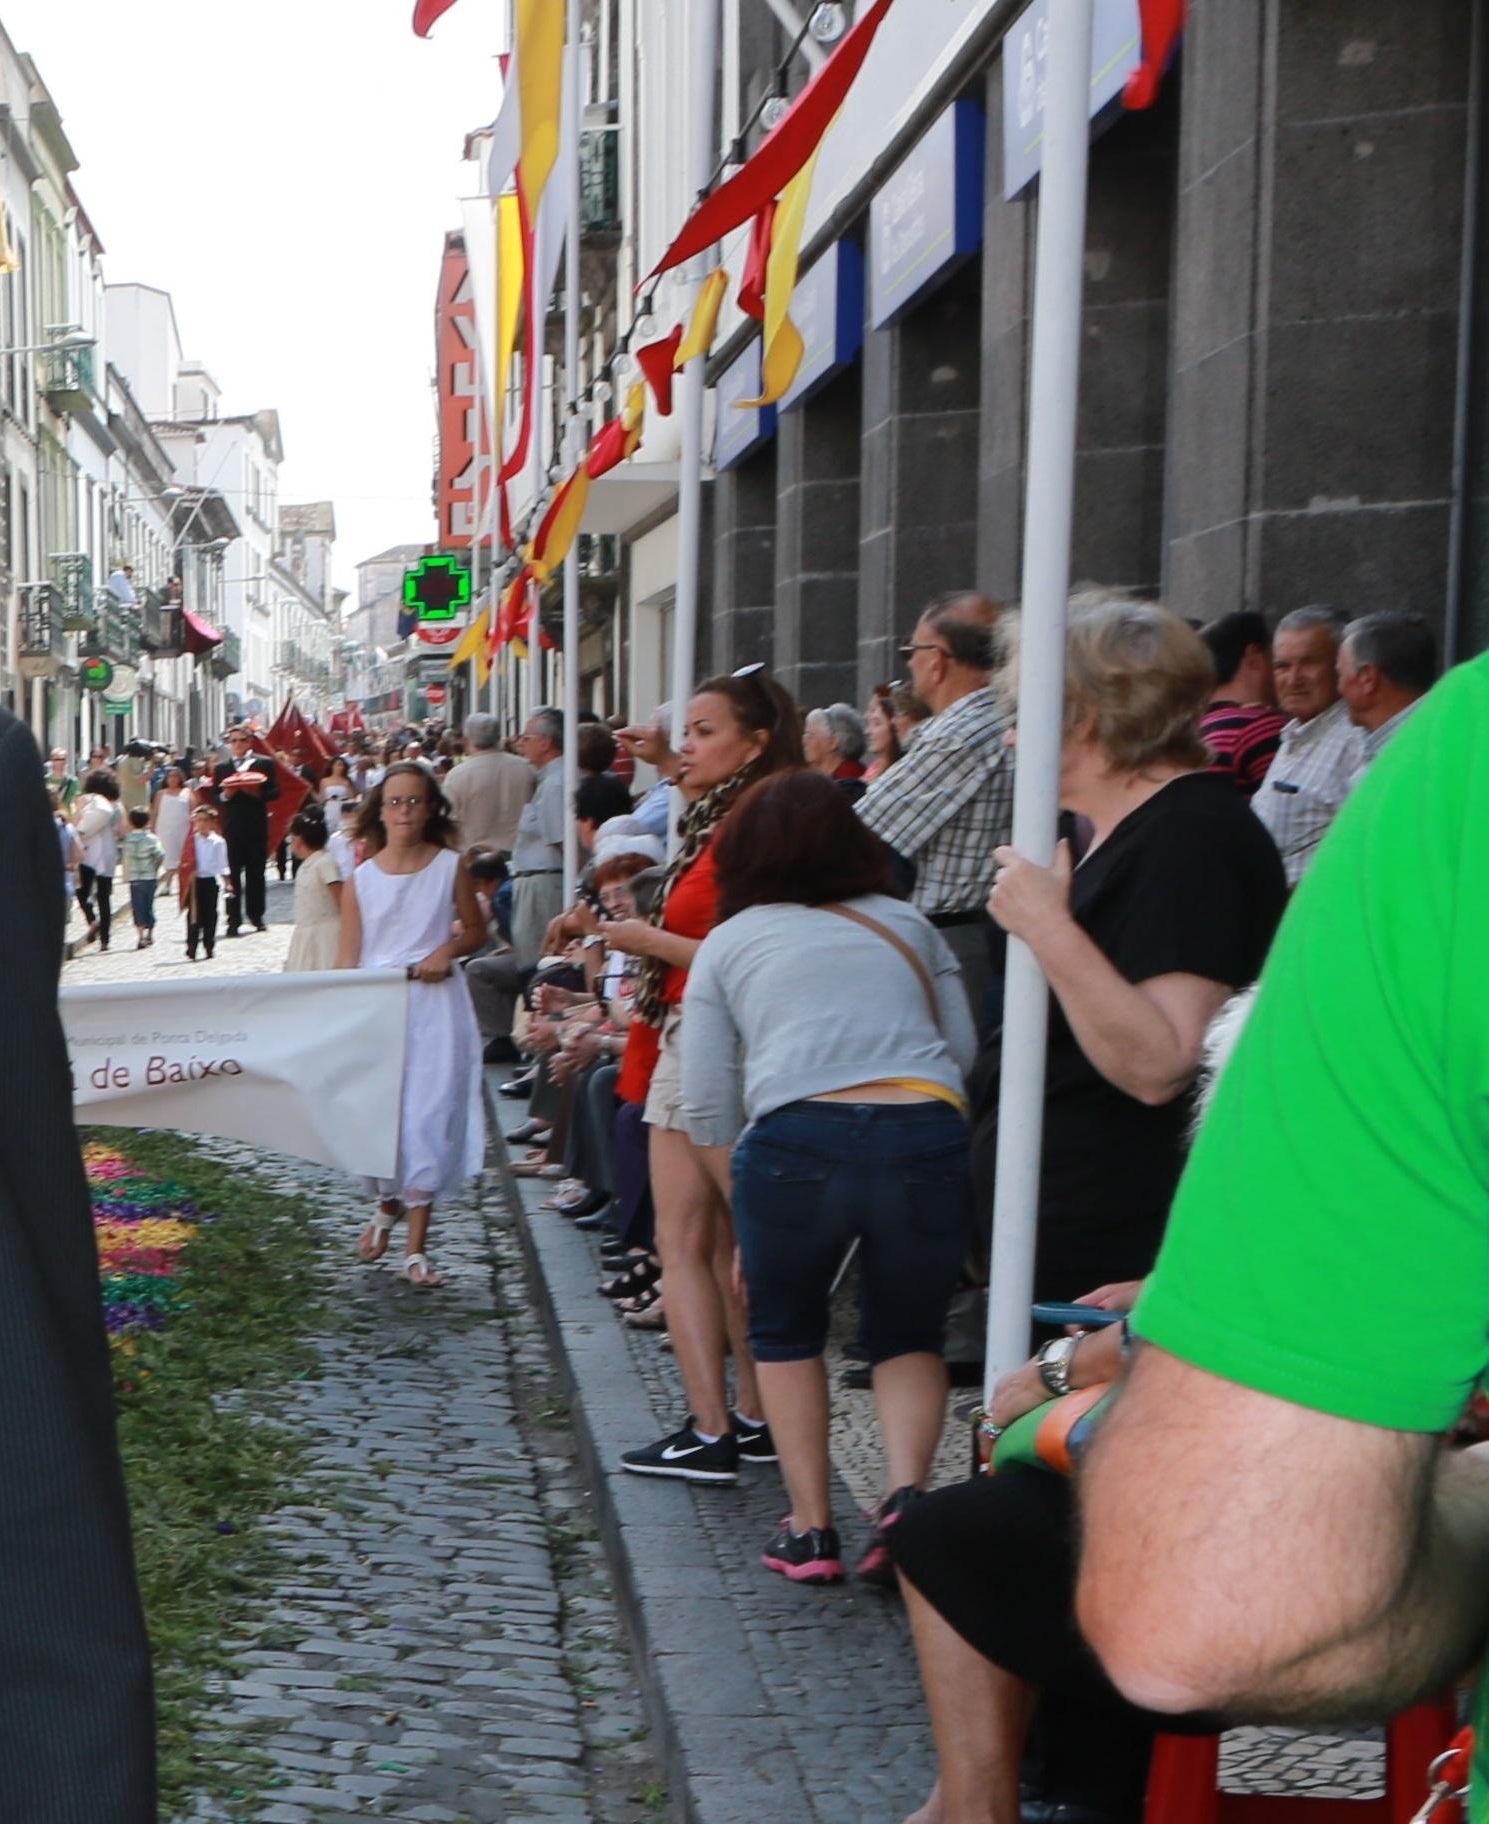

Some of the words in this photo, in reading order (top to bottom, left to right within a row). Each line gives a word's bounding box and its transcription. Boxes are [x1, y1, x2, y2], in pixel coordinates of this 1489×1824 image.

[131, 1033, 147, 1045] de
[152, 1031, 191, 1044] Ponta
[195, 1030, 248, 1046] Delgada
[91, 1057, 130, 1089] de
[146, 1055, 243, 1086] Baixo
